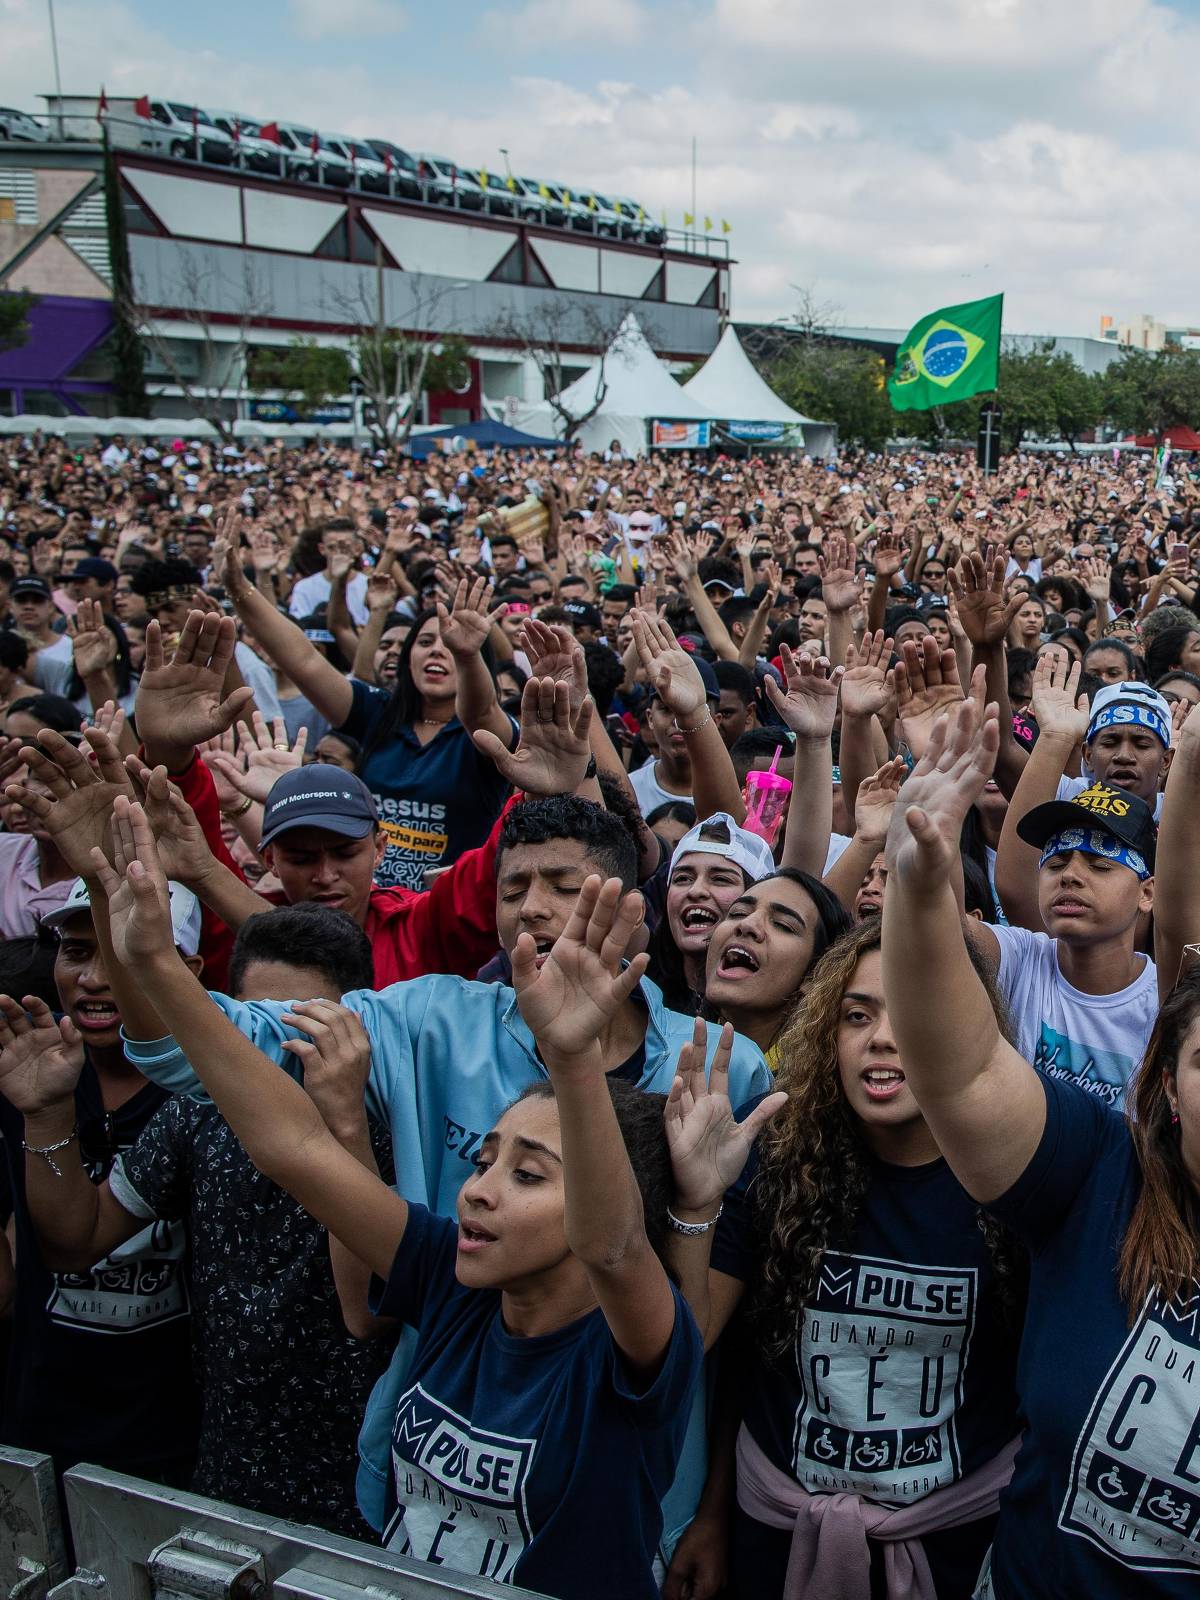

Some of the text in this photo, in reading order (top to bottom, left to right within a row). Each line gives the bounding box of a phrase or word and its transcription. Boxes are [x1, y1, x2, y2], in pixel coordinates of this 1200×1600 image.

[271, 791, 338, 813] BMW Motorsport
[811, 1319, 915, 1346] QUANDO
[809, 1346, 945, 1422] CÉU
[805, 1470, 858, 1491] INVADE
[891, 1475, 941, 1496] TERRA
[1084, 1500, 1139, 1542] INVADE
